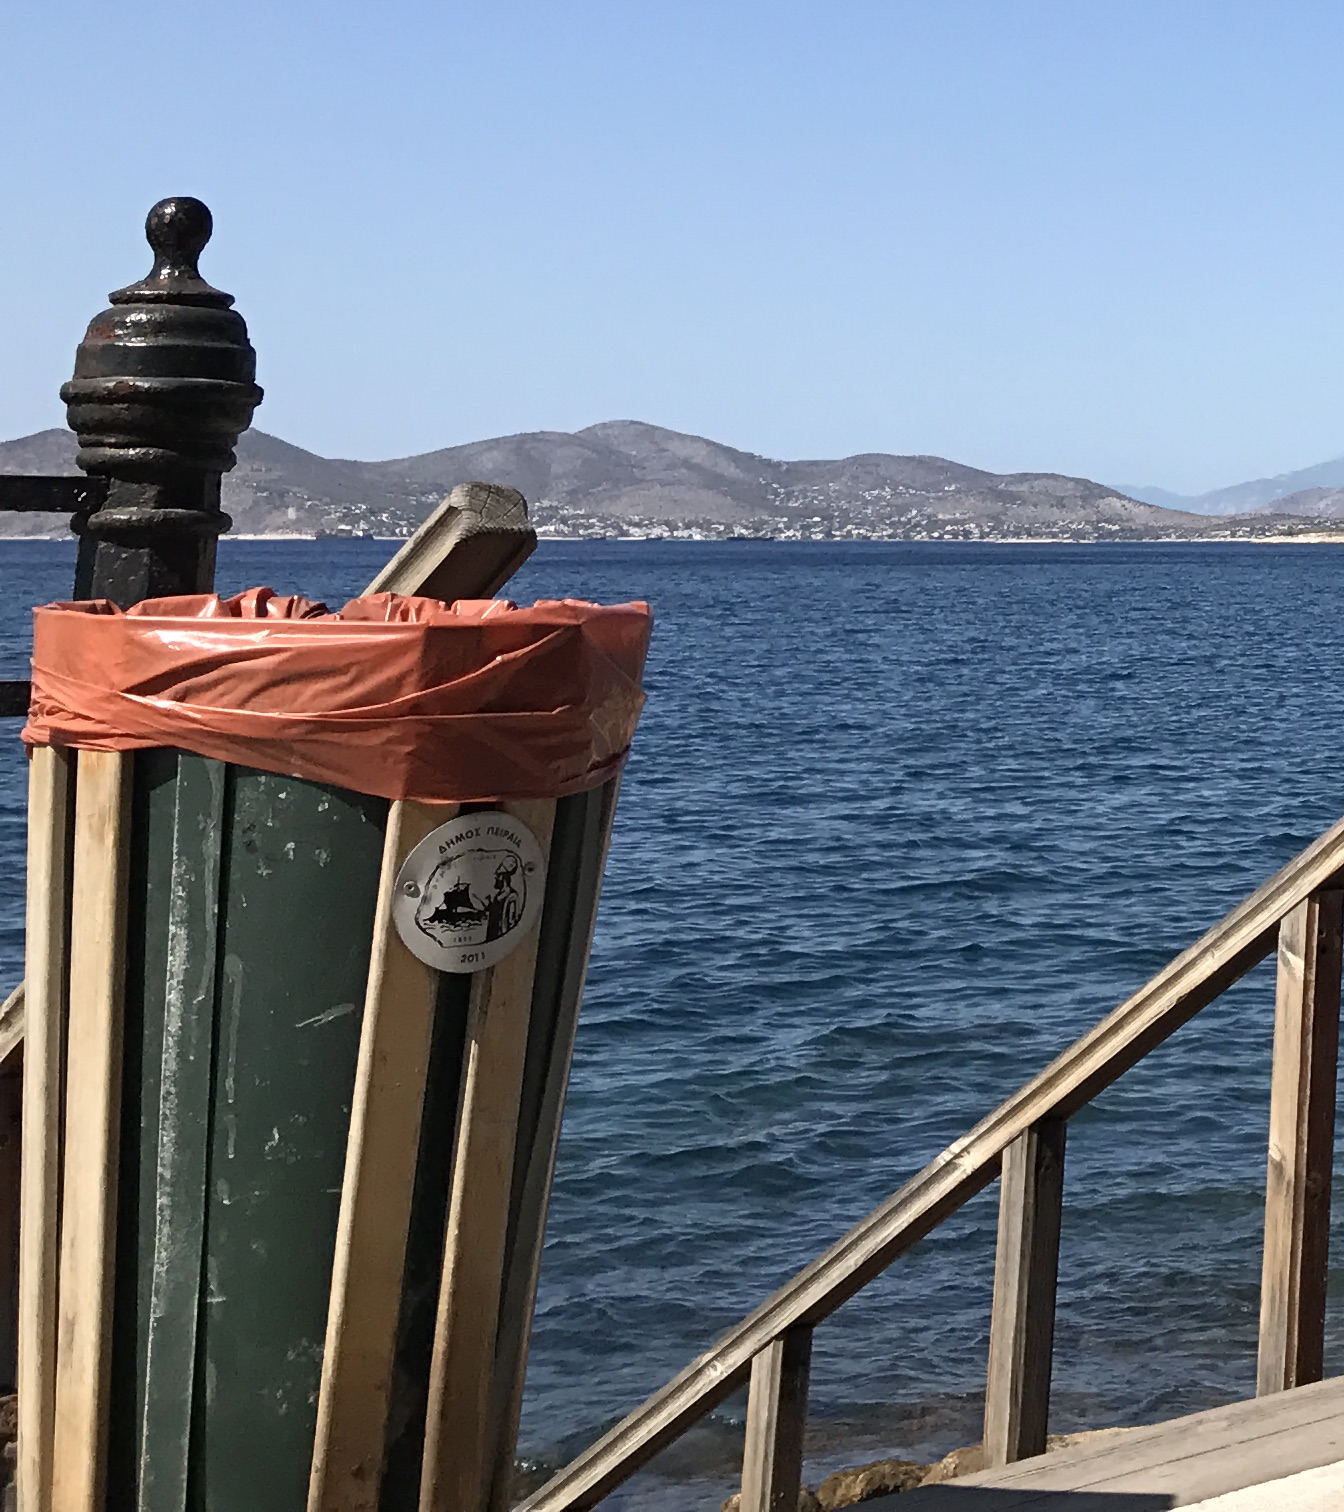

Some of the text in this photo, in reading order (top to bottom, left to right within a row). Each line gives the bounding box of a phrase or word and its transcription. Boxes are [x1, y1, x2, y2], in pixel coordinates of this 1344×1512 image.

[438, 826, 523, 855] ΔΗΜΟΣ ΠΕΙΡΑΙΑ
[460, 951, 486, 963] 2011
